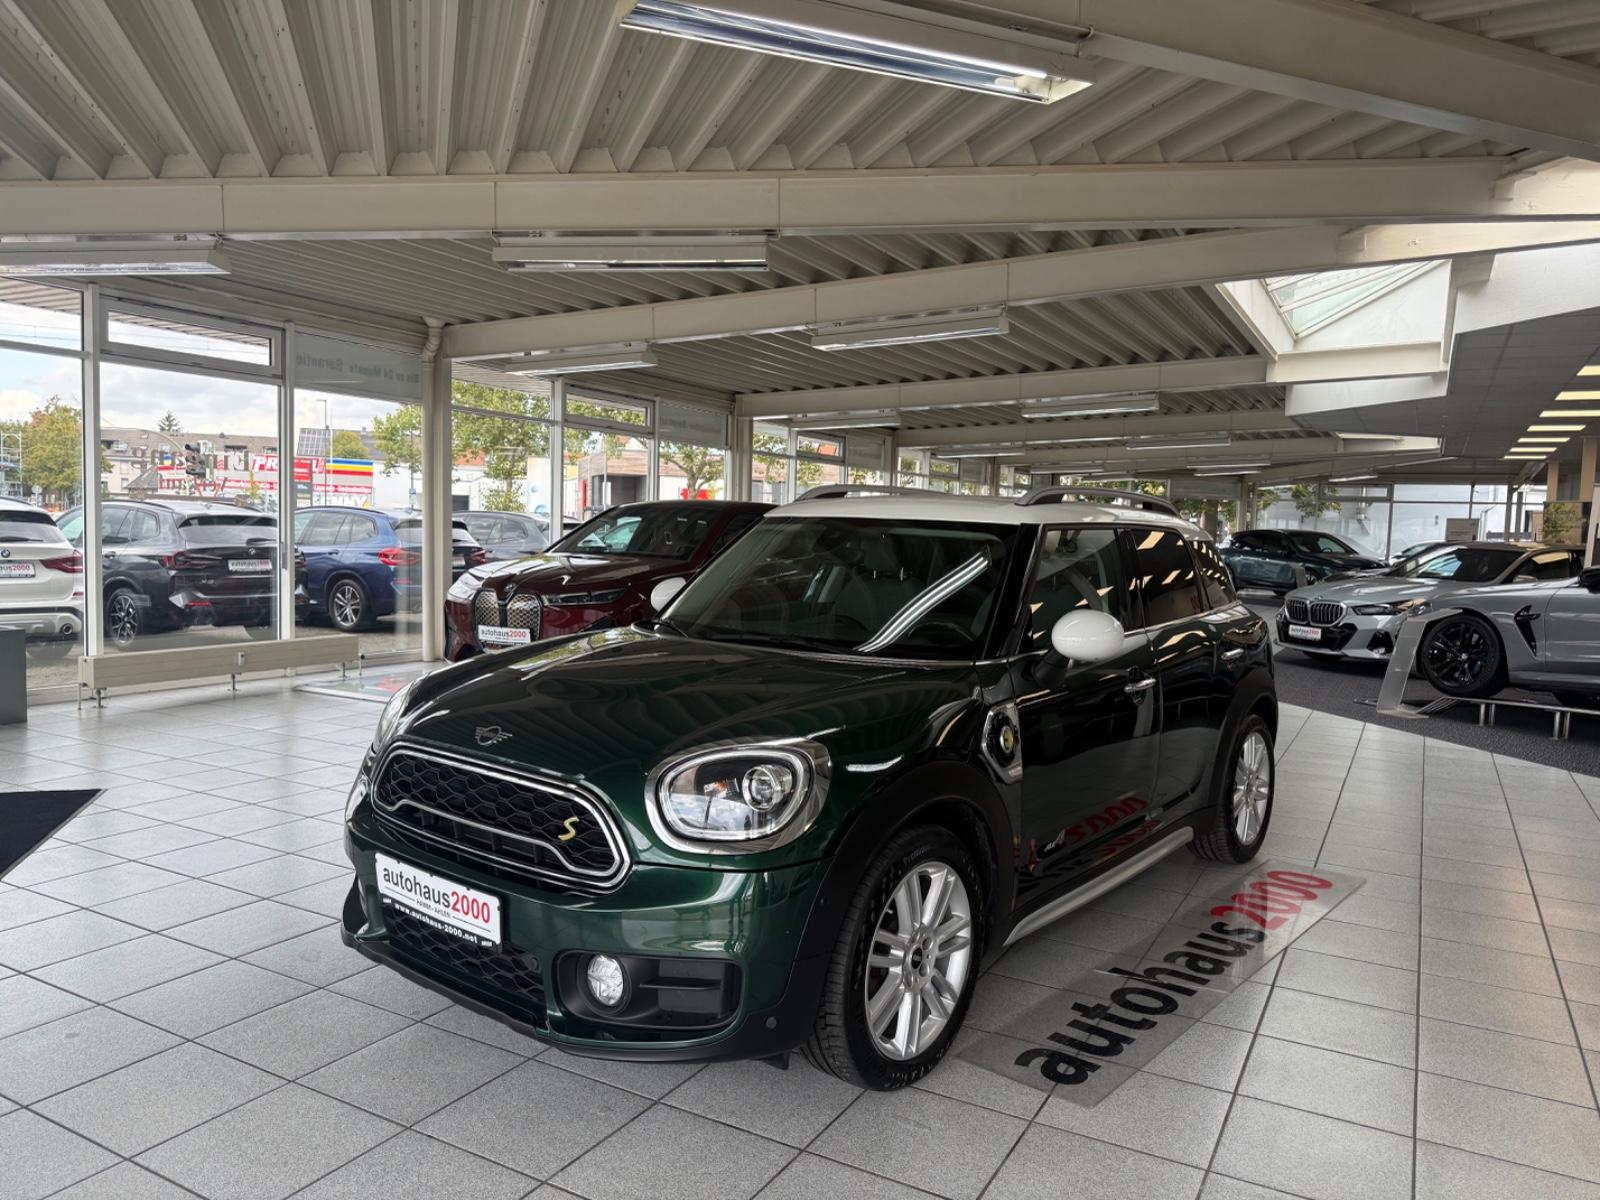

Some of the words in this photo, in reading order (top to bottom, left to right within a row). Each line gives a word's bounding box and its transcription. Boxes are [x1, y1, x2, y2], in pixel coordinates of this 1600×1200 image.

[481, 629, 527, 638] autohaus2000
[557, 815, 580, 841] S
[383, 867, 491, 924] autohaus2000
[394, 903, 479, 944] www.autohaus-2000.net
[1014, 870, 1334, 1085] autohaus2000
